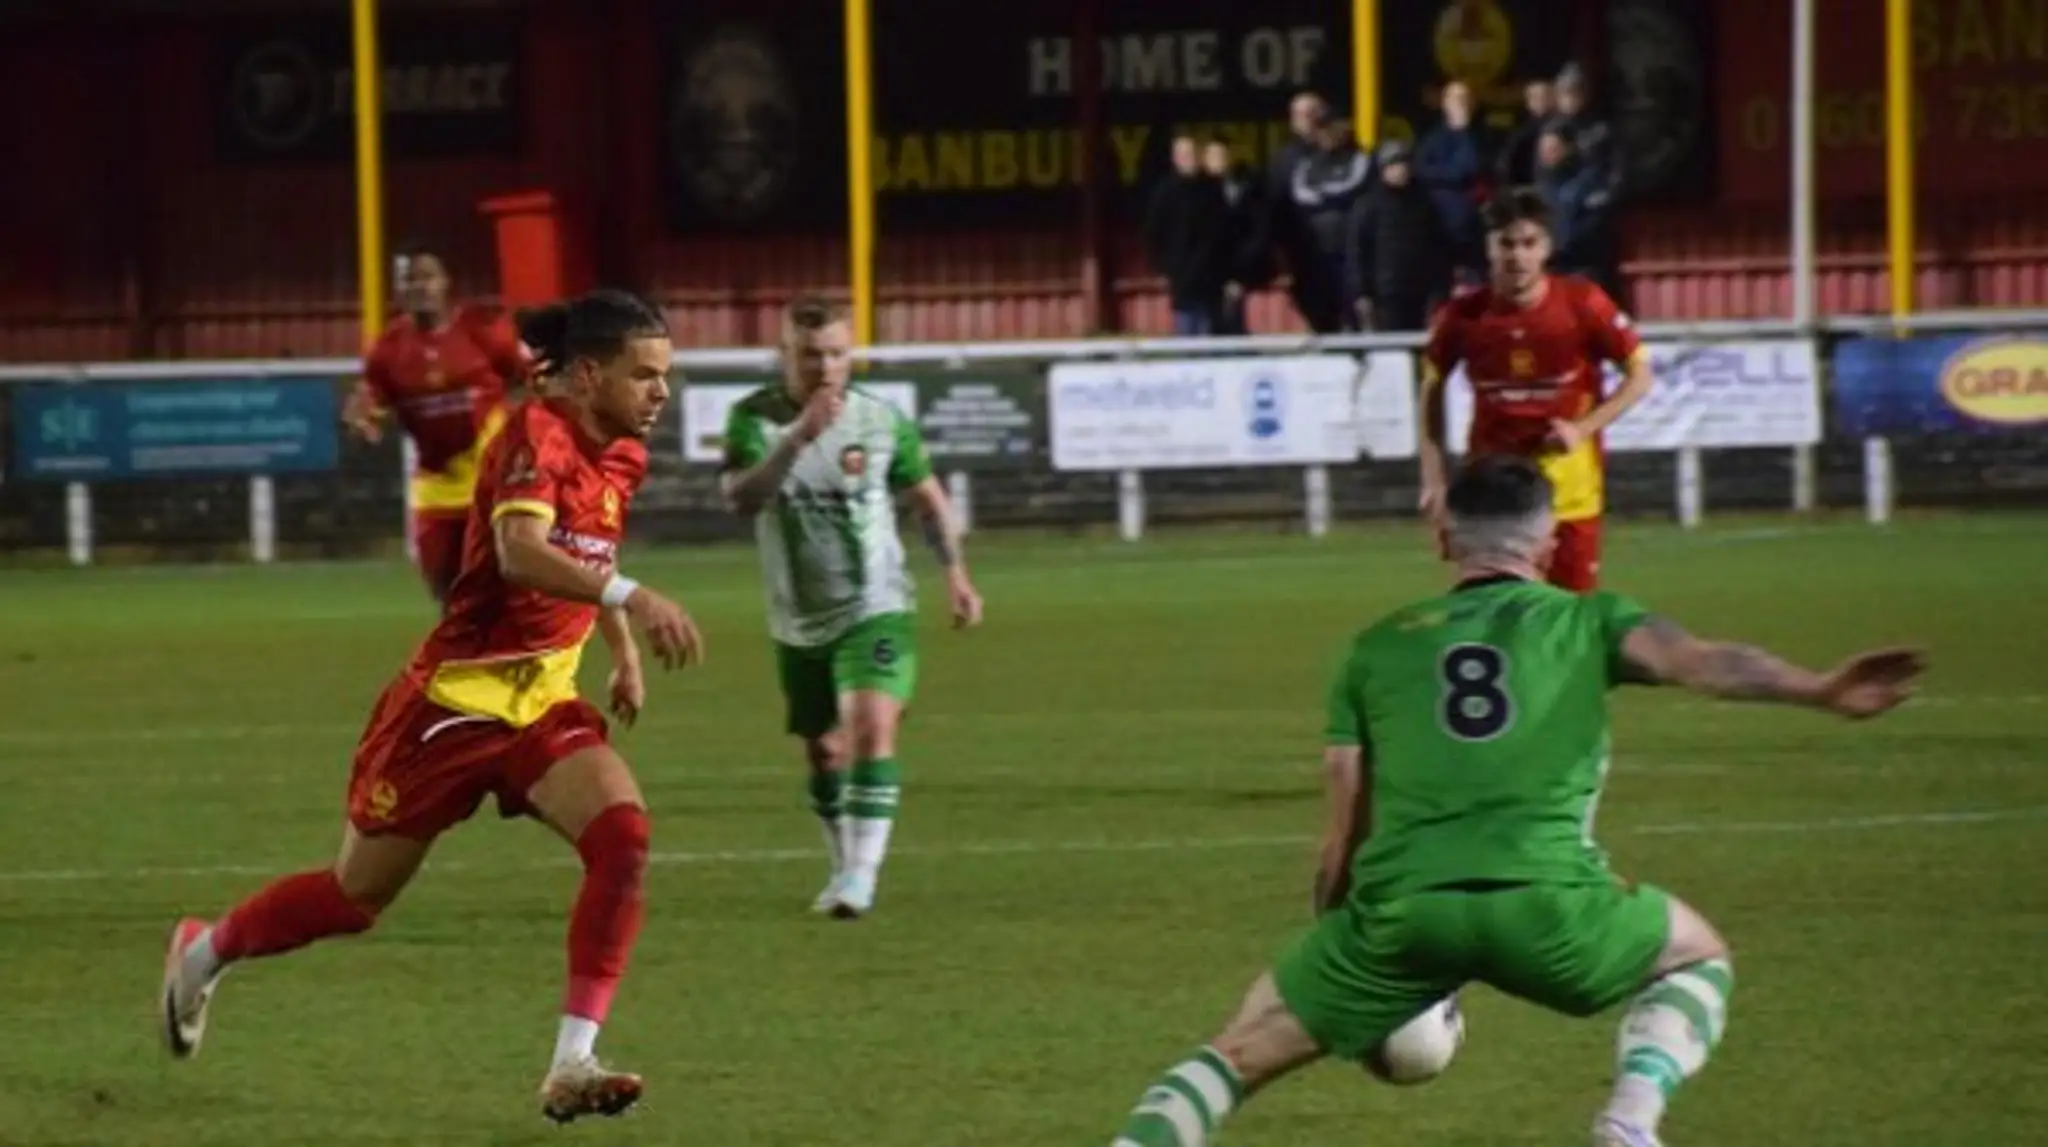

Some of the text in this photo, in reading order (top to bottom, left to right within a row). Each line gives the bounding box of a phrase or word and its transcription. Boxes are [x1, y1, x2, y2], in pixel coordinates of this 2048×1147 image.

[1242, 25, 1326, 89] OF
[872, 637, 898, 666] 6
[1439, 642, 1514, 742] 8
